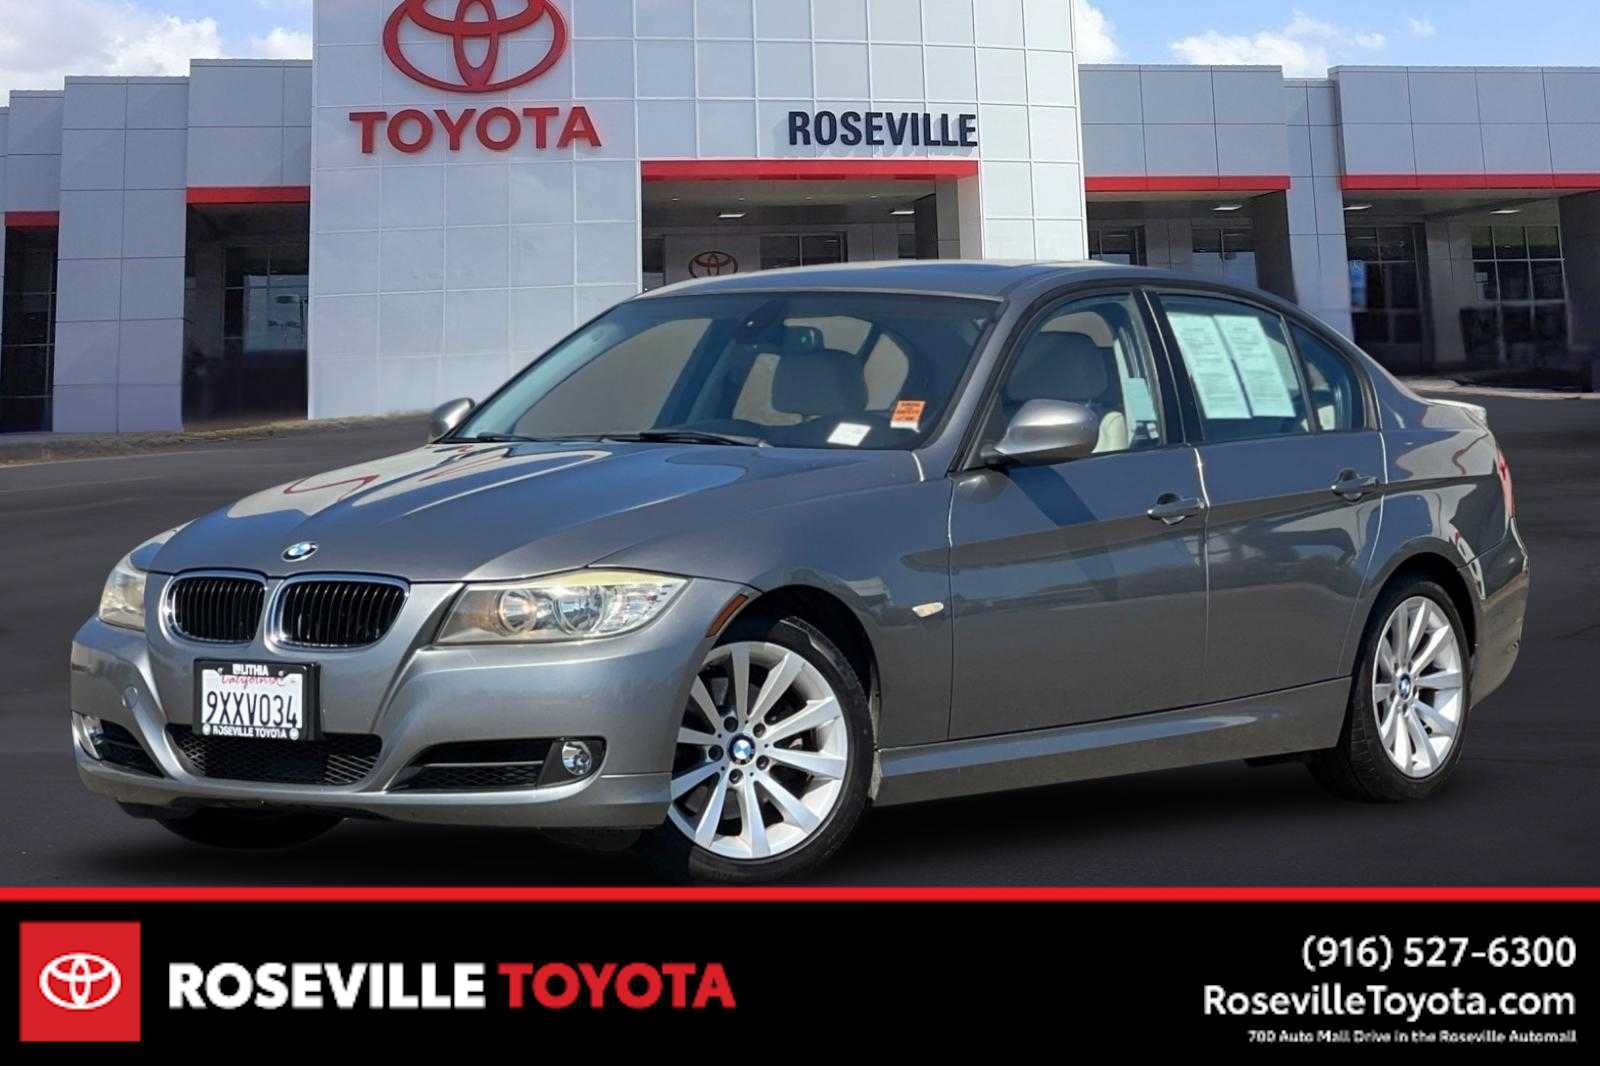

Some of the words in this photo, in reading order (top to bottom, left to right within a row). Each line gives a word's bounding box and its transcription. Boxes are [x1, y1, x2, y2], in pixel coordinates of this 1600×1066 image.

[349, 106, 602, 154] TOYOTA
[788, 110, 979, 148] ROSEVILLE
[241, 664, 269, 676] LITHIA
[206, 691, 298, 727] 9XXV034
[212, 725, 254, 737] ROSEVILLE
[255, 727, 288, 739] TOYOTA
